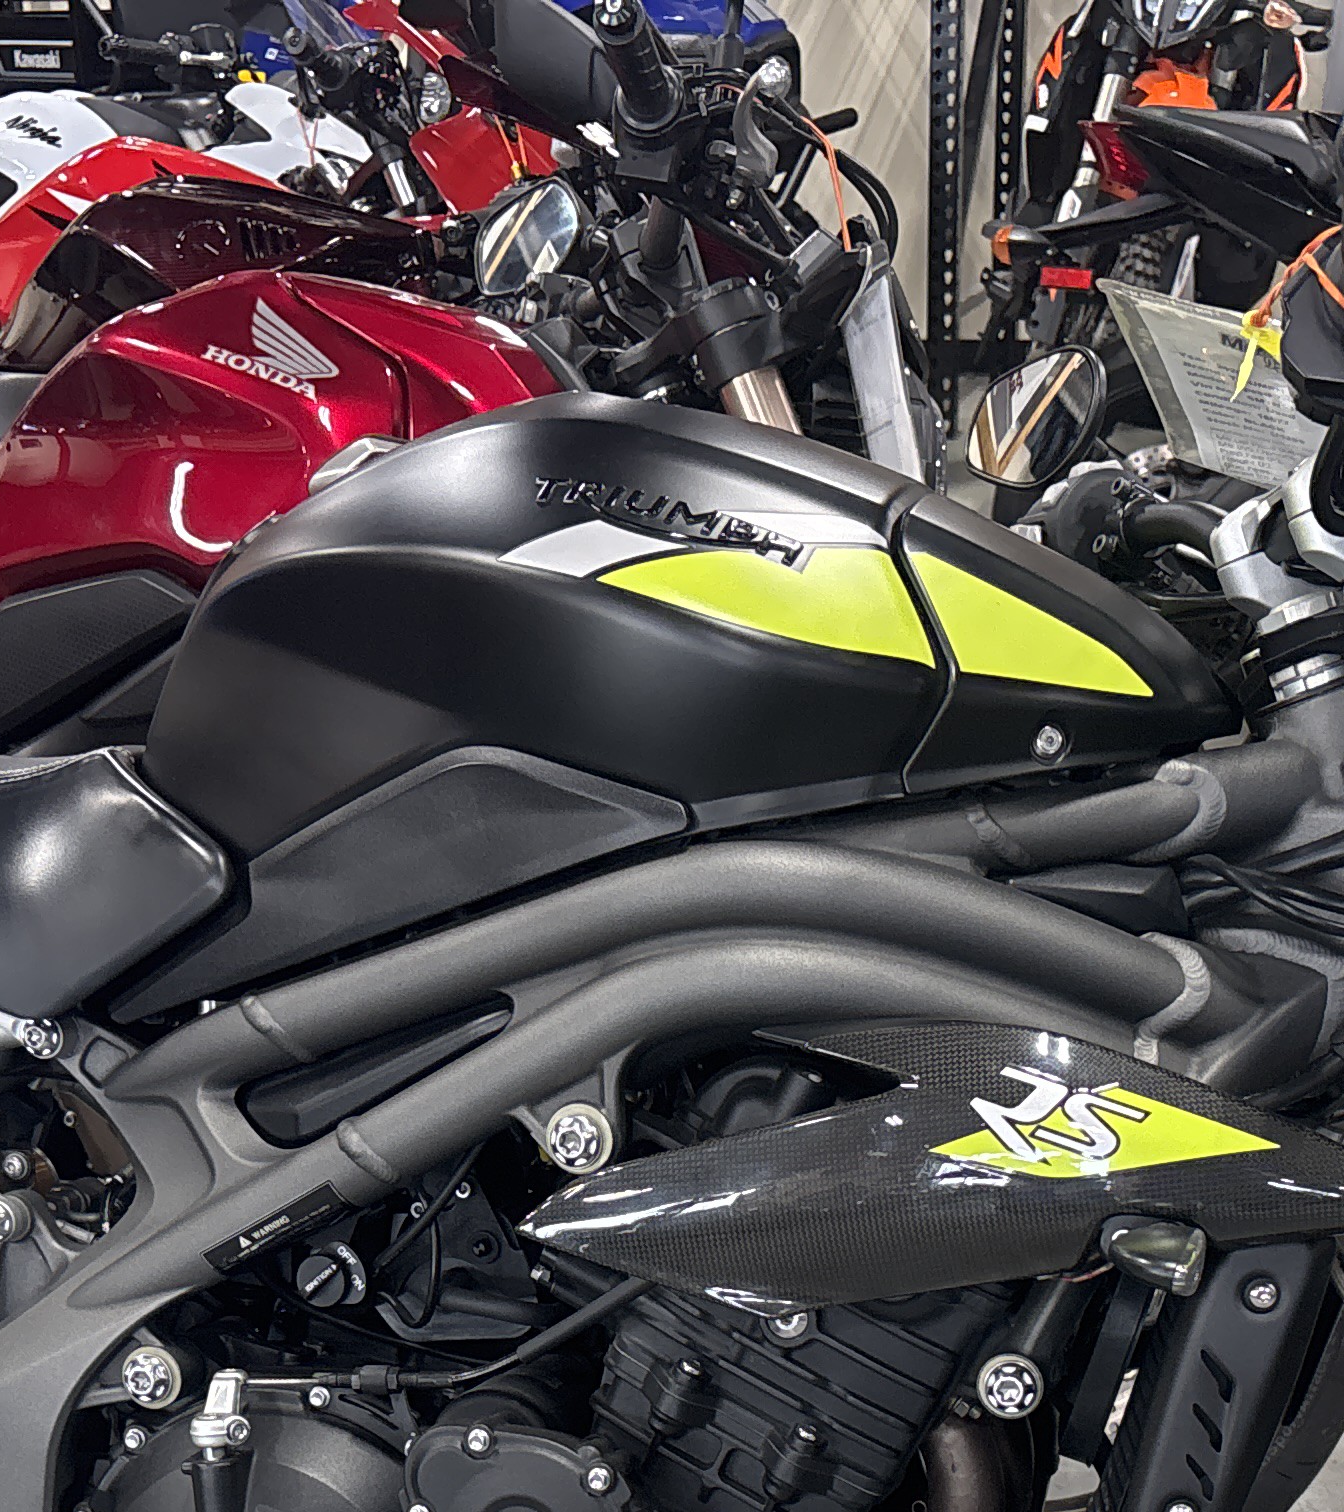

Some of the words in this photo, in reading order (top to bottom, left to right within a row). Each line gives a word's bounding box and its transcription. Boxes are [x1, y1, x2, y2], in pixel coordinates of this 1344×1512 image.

[13, 49, 62, 69] Kawasaki
[5, 114, 63, 149] Ninja
[199, 343, 318, 404] HONDA
[535, 475, 805, 568] TRIUMPH
[968, 1063, 1154, 1166] RS
[250, 1214, 291, 1241] WARNING
[336, 1245, 358, 1266] OFF
[350, 1273, 366, 1292] ON
